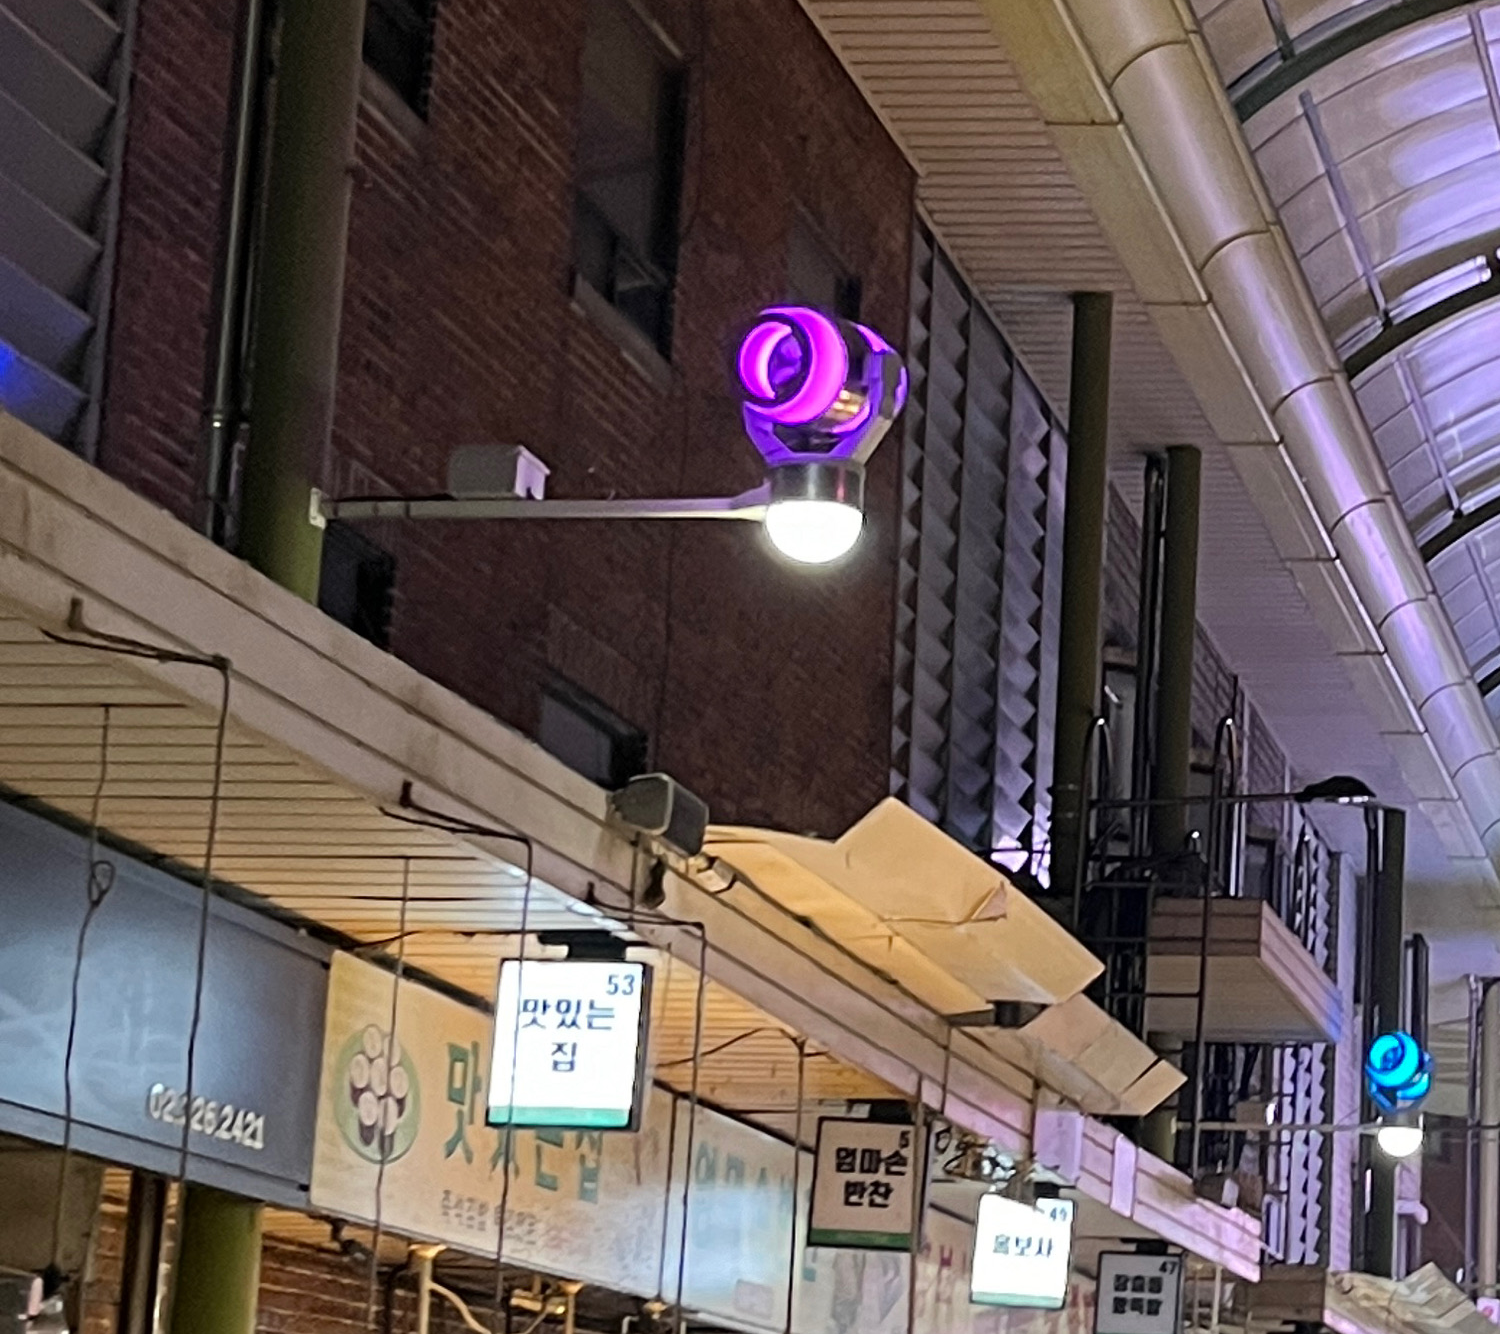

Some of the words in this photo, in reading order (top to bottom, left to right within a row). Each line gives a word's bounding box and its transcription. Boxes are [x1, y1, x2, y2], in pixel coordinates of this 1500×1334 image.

[605, 973, 636, 996] 53
[520, 997, 616, 1030] 맛있는
[551, 1041, 579, 1073] 집
[835, 1146, 910, 1177] 엄마손
[843, 1179, 895, 1209] 반찬
[1158, 1260, 1179, 1275] 47
